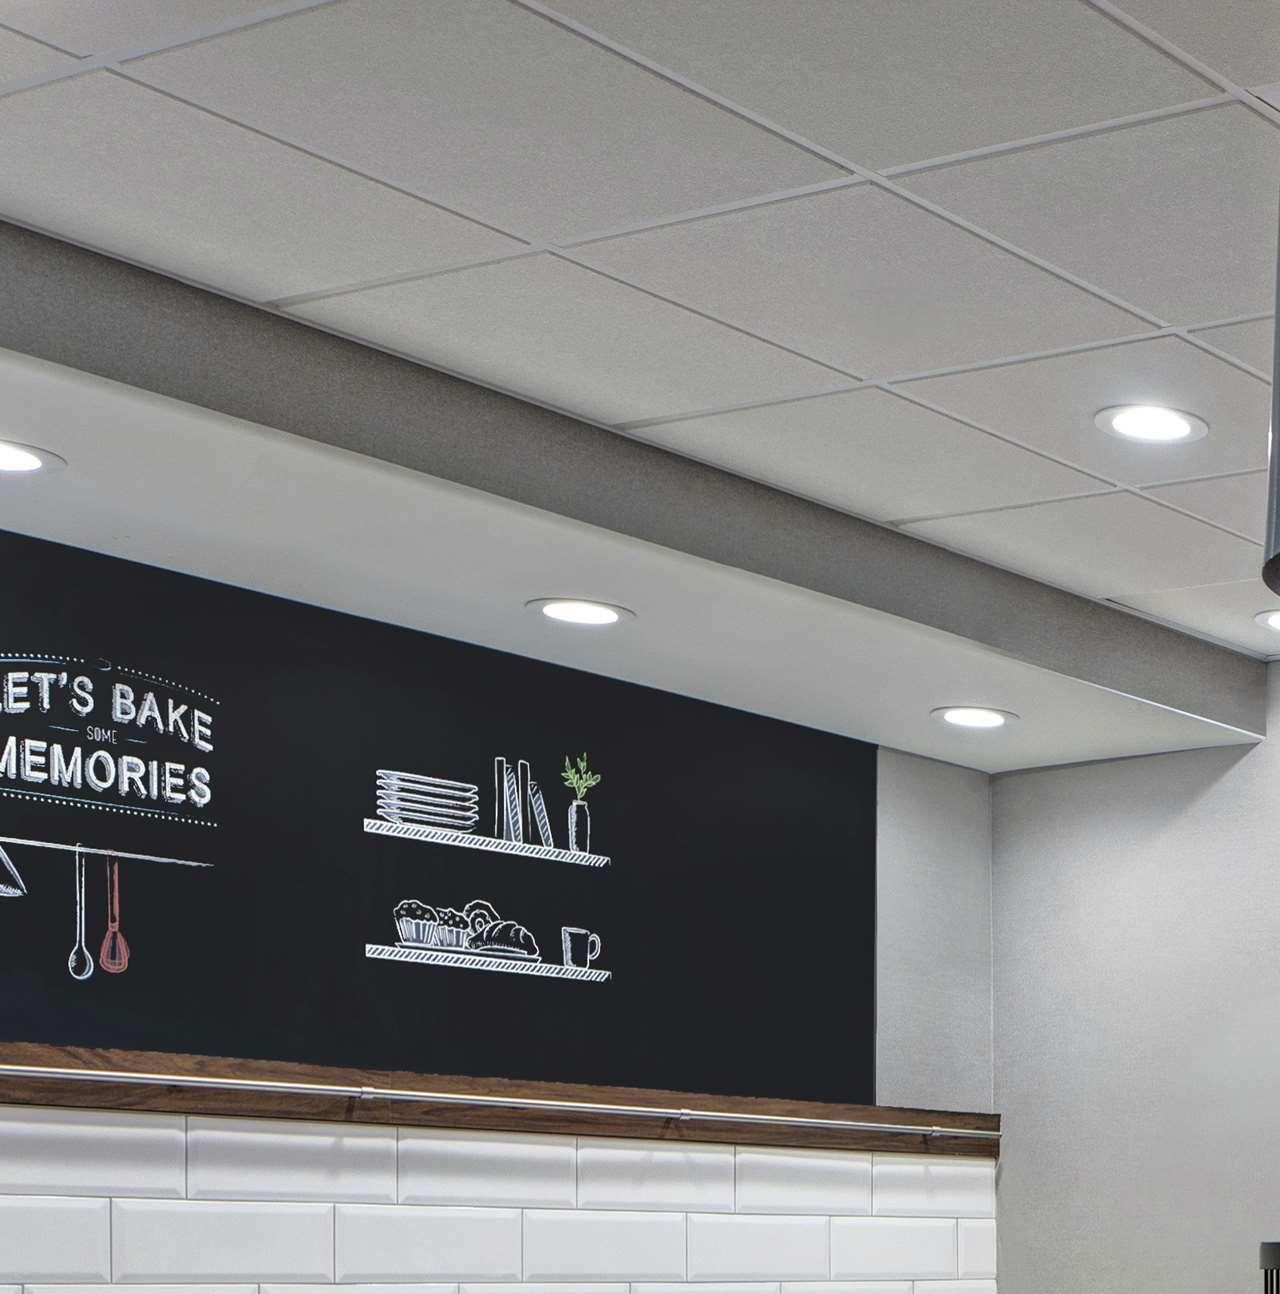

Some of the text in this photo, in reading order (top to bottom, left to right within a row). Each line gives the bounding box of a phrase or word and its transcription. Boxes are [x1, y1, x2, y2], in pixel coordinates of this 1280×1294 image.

[0, 671, 214, 752] ET'S BAKE
[86, 726, 118, 745] SOME
